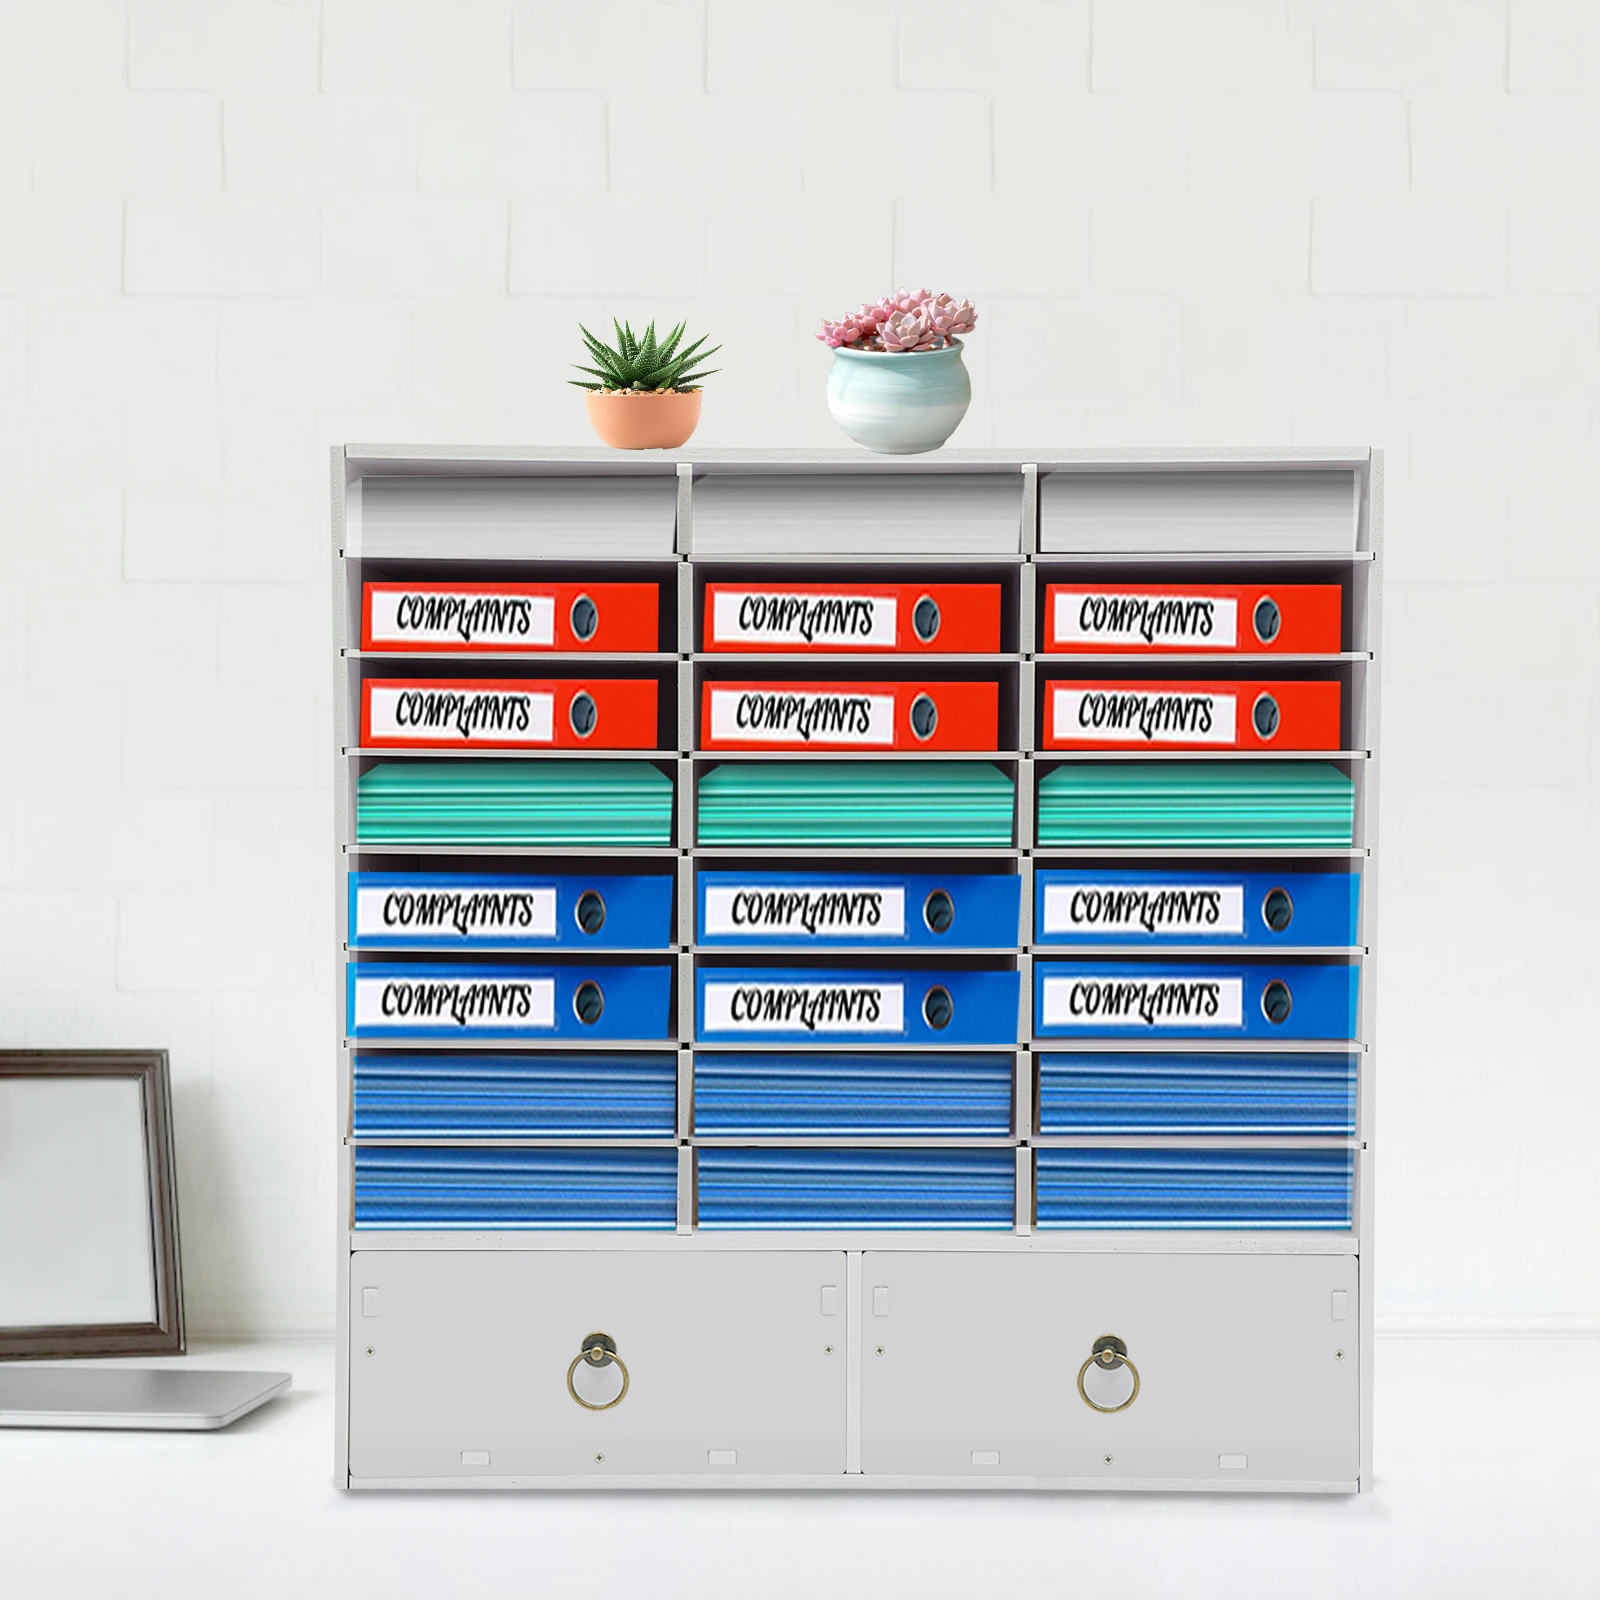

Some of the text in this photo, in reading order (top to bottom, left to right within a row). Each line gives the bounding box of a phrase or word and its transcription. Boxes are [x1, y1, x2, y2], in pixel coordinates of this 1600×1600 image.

[396, 595, 532, 642] COMPLAINTS
[739, 596, 874, 642] COMPLAINTS
[1079, 597, 1214, 643] COMPLAINTS
[395, 692, 531, 738] COMPLAINTS
[736, 694, 871, 740] COMPLAINTS
[1078, 693, 1214, 740] COMPLAINTS
[383, 893, 534, 935] COMPLAINTS
[731, 892, 882, 935] COMPLAINTS
[1070, 891, 1221, 933] COMPLAINTS
[381, 984, 532, 1026] COMPLAINTS
[730, 989, 881, 1031] COMPLAINTS
[1069, 983, 1220, 1025] COMPLAINTS
